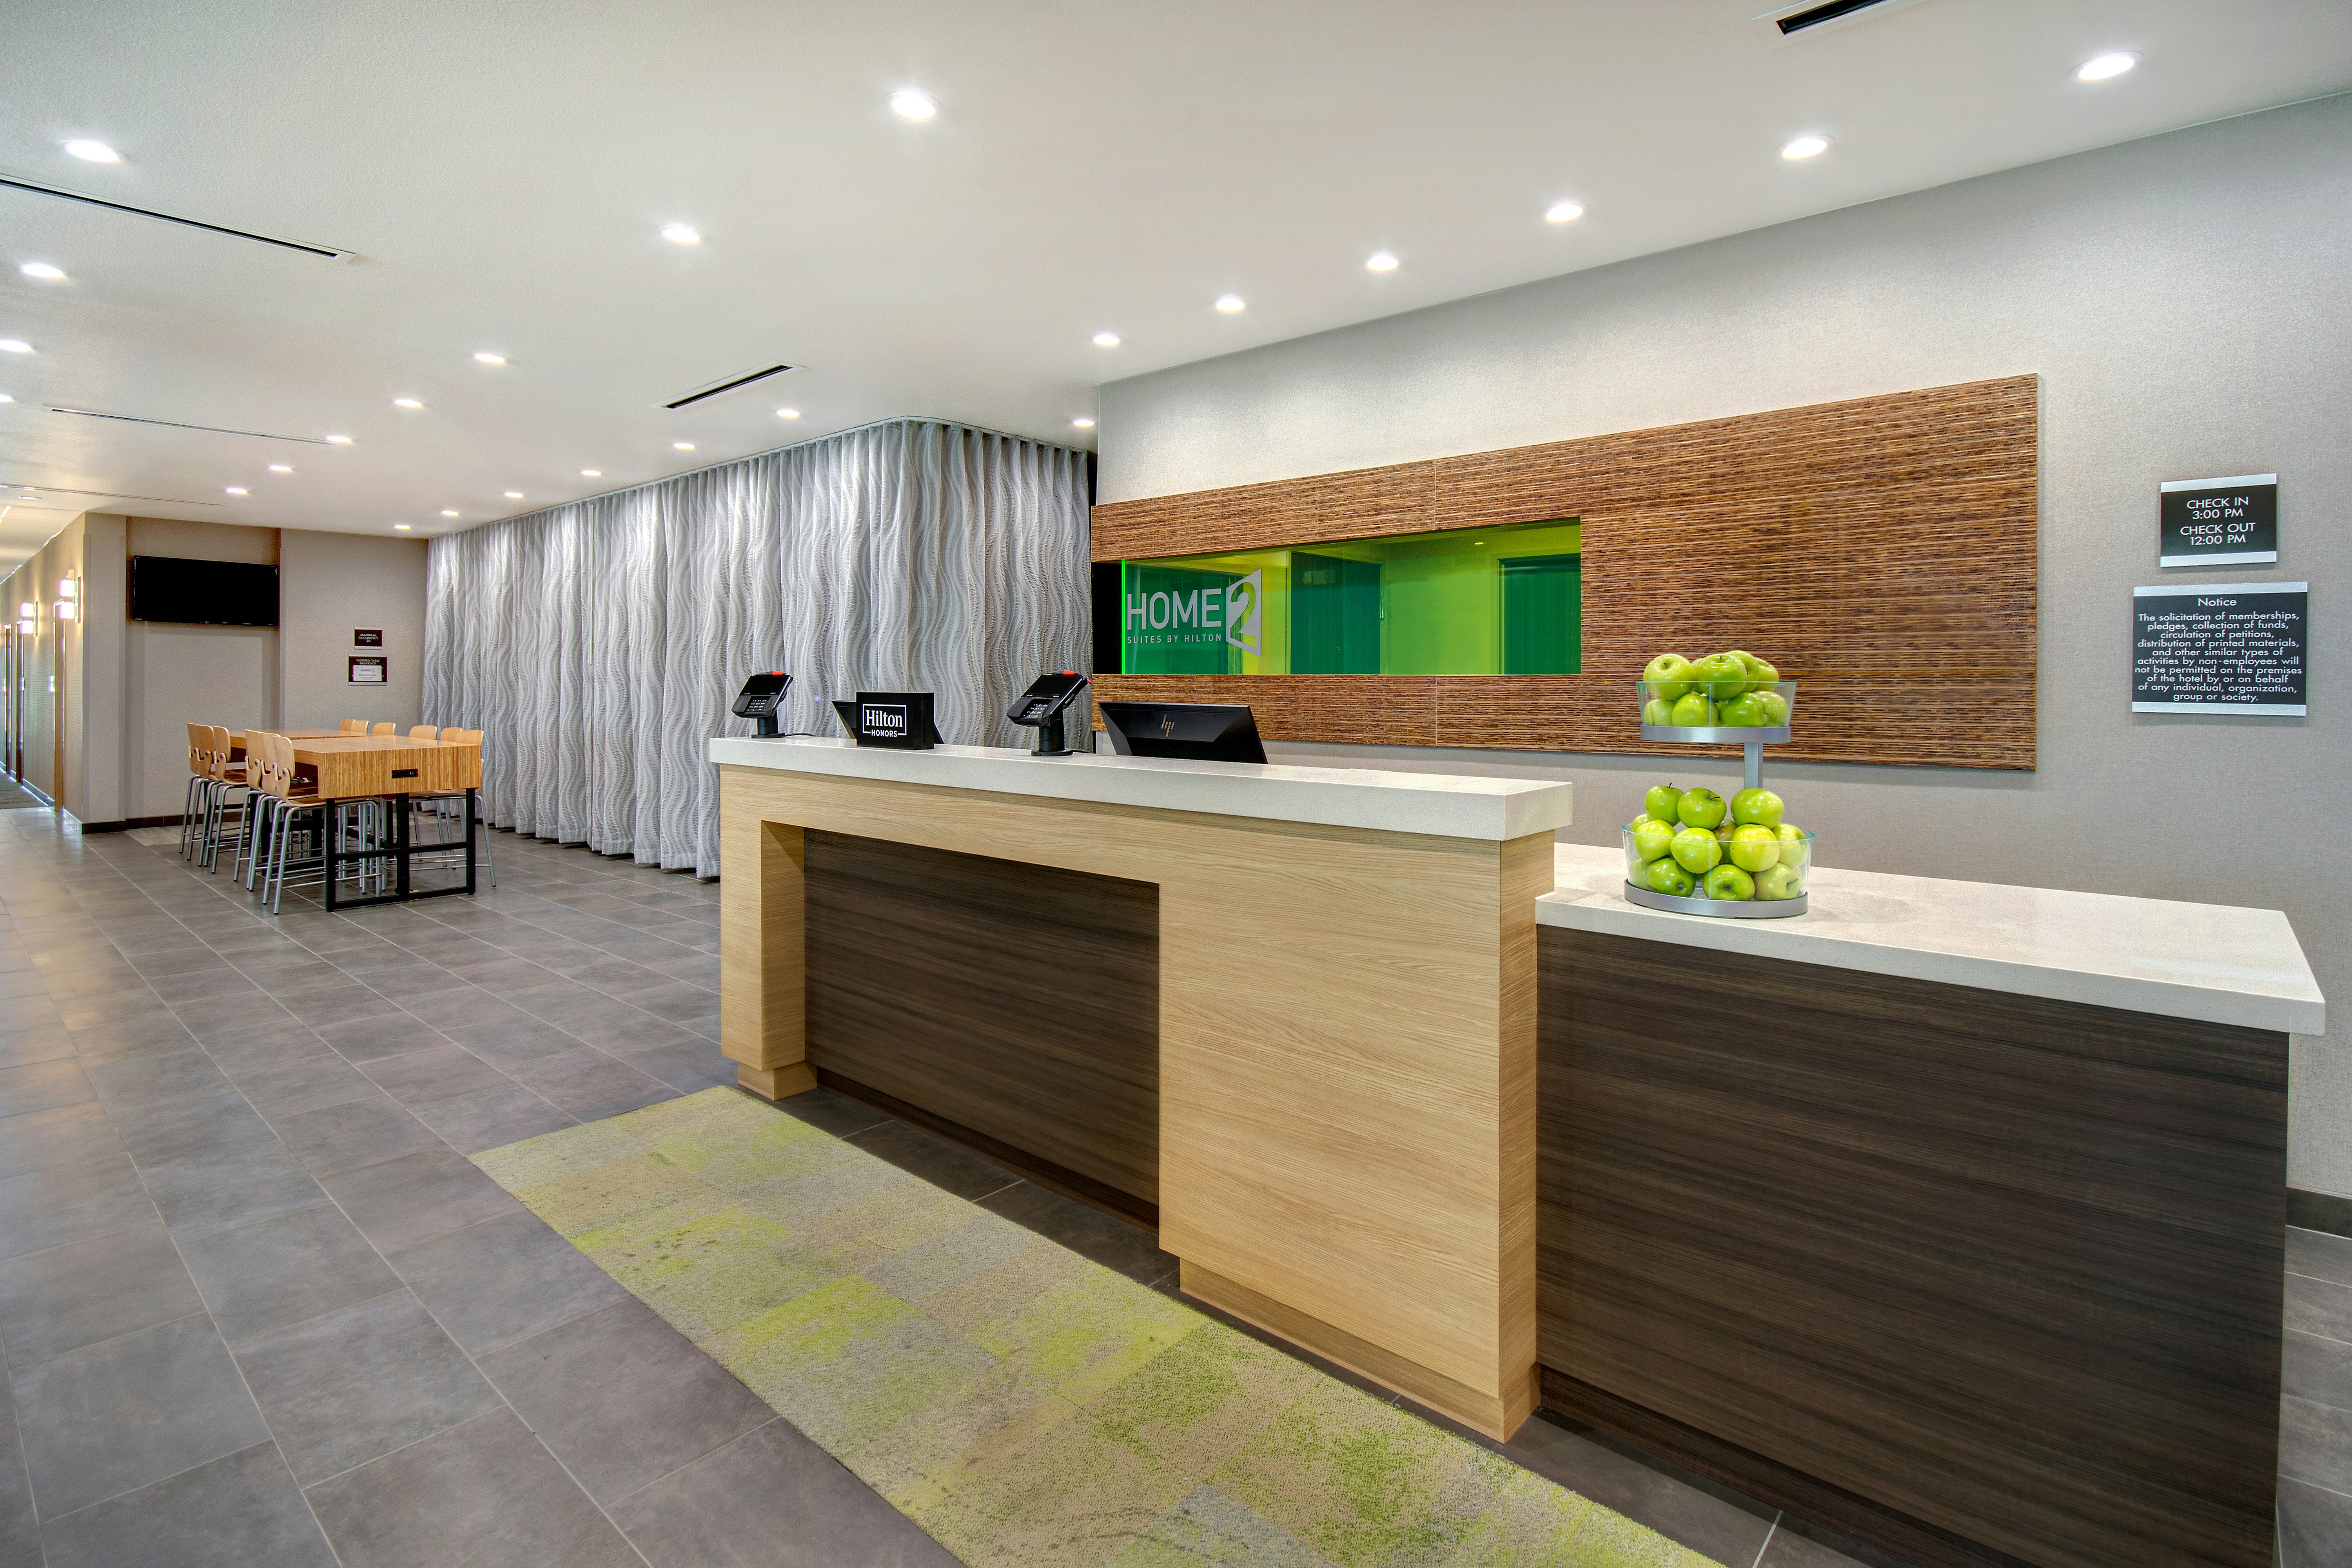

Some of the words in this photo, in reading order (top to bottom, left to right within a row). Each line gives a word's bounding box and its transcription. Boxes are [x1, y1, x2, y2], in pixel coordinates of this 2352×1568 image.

[2187, 497, 2230, 509] CHECK
[2234, 496, 2249, 506] IN
[2192, 509, 2220, 519] 3:00
[2225, 508, 2243, 517] PM
[2180, 524, 2223, 535] CHECK
[2227, 522, 2256, 533] OUT
[2190, 535, 2222, 545] 12:00
[2227, 534, 2246, 543] PM
[2198, 597, 2237, 606] Notice
[1127, 588, 1221, 630] HOME
[1230, 580, 1258, 648] 2
[2138, 613, 2156, 621] The
[2159, 612, 2211, 621] solicitation
[2215, 612, 2225, 620] of
[2229, 610, 2299, 621] memberships,
[2148, 621, 2188, 632] pledges,
[2192, 621, 2239, 629] collection
[2244, 620, 2255, 629] of
[2258, 620, 2288, 630] funds,
[1127, 635, 1161, 644] SUITES
[1167, 635, 1178, 643] BY
[1184, 633, 1221, 642] HILTON
[2160, 630, 2211, 639] circulation
[2215, 630, 2226, 638] of
[2229, 630, 2275, 640] petitions,
[2138, 639, 2191, 647] distribution
[2195, 638, 2206, 647] of
[2209, 638, 2245, 650] printed
[2249, 638, 2299, 648] materials,
[2152, 647, 2171, 656] and
[2175, 647, 2201, 656] other
[2205, 647, 2238, 656] similar
[2241, 649, 2269, 658] types
[2273, 647, 2284, 655] of
[2183, 656, 2195, 666] by
[2199, 656, 2277, 667] non-employees
[2281, 656, 2299, 665] will
[2153, 665, 2166, 673] be
[2169, 665, 2216, 675] permitted
[2238, 665, 2252, 673] the
[2257, 666, 2302, 676] premises
[2147, 673, 2157, 682] of
[2160, 673, 2175, 682] the
[2179, 673, 2203, 682] hotel
[2207, 674, 2220, 684] by
[2256, 674, 2288, 683] behalf
[2138, 682, 2148, 690] of
[2173, 682, 2224, 693] individual,
[2229, 684, 2297, 694] organization,
[2221, 693, 2258, 702] society.
[866, 710, 903, 727] Hilton
[871, 729, 898, 737] HONORS
